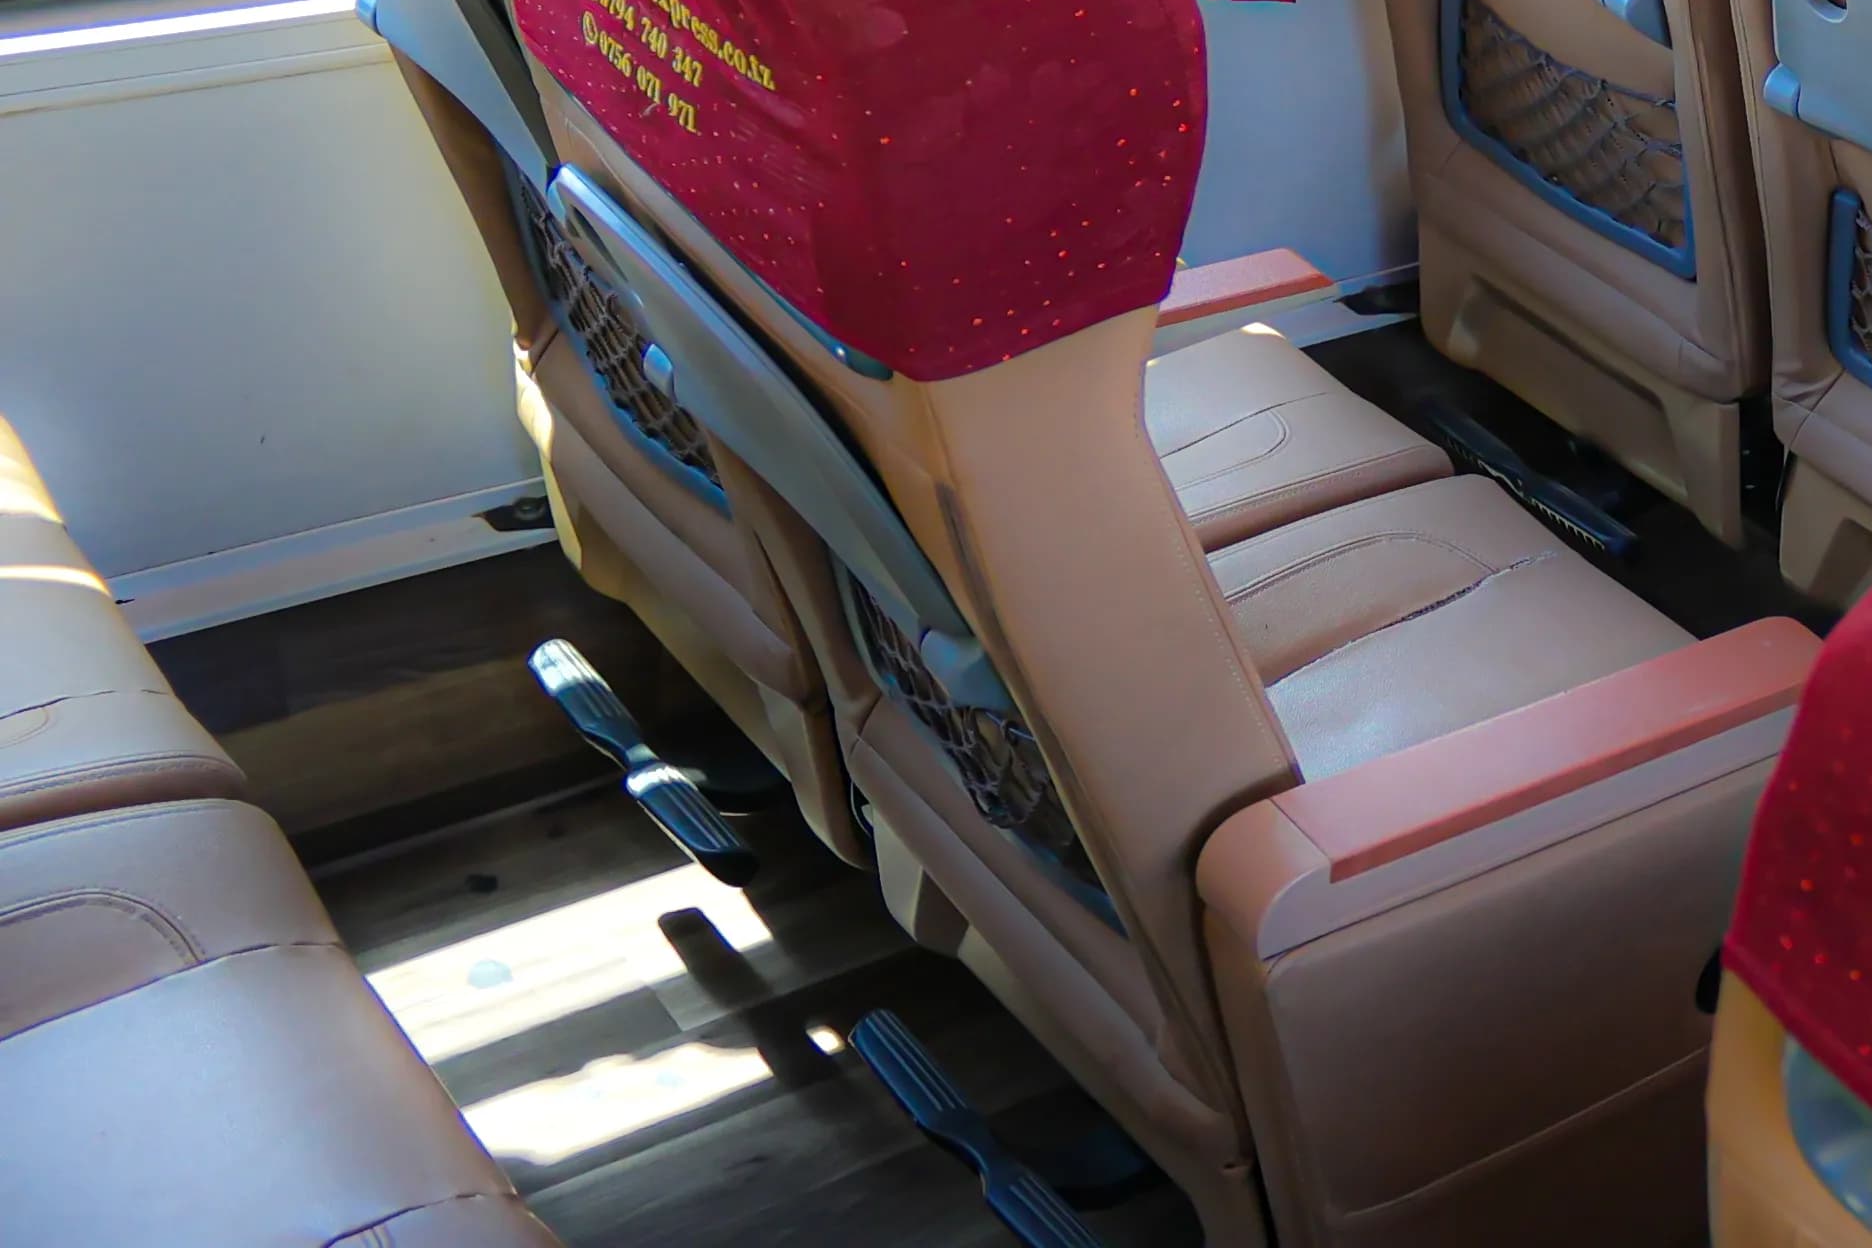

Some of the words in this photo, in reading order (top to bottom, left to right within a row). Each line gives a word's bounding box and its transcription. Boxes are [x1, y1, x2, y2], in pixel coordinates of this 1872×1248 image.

[600, 31, 631, 77] 0756
[637, 66, 662, 104] 071
[668, 93, 697, 134] 971
[641, 17, 668, 59] 740
[672, 46, 702, 87] 347
